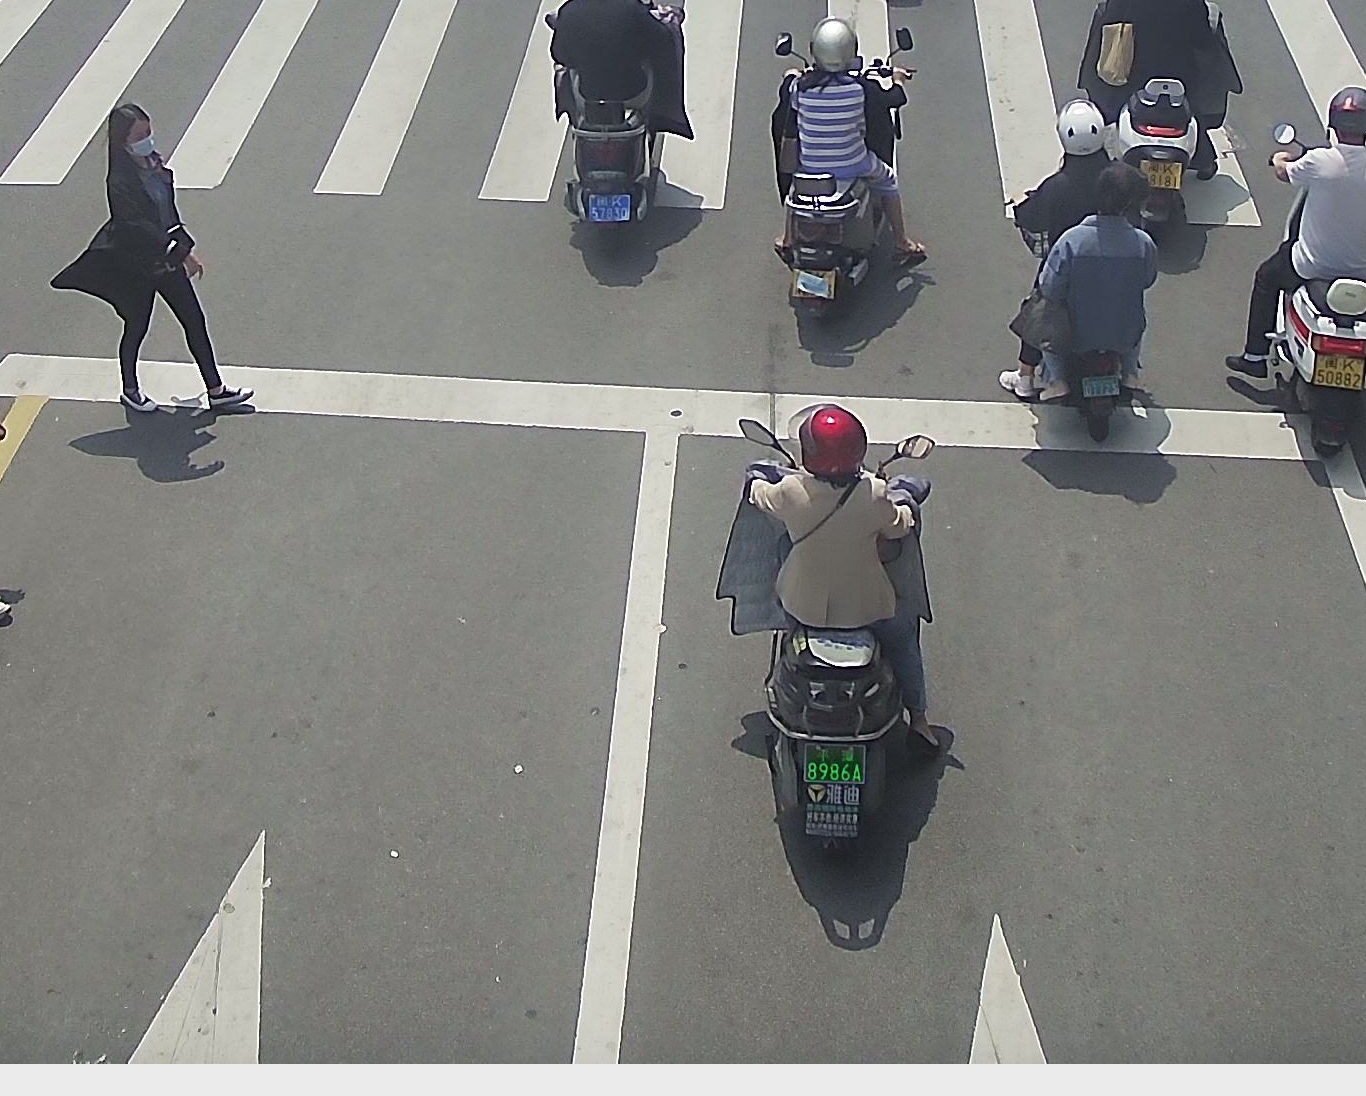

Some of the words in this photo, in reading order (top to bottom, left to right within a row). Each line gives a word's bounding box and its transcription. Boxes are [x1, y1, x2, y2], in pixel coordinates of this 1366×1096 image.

[1317, 369, 1361, 388] 50882
[807, 762, 861, 782] 8986A
[826, 784, 860, 805] 雅迪
